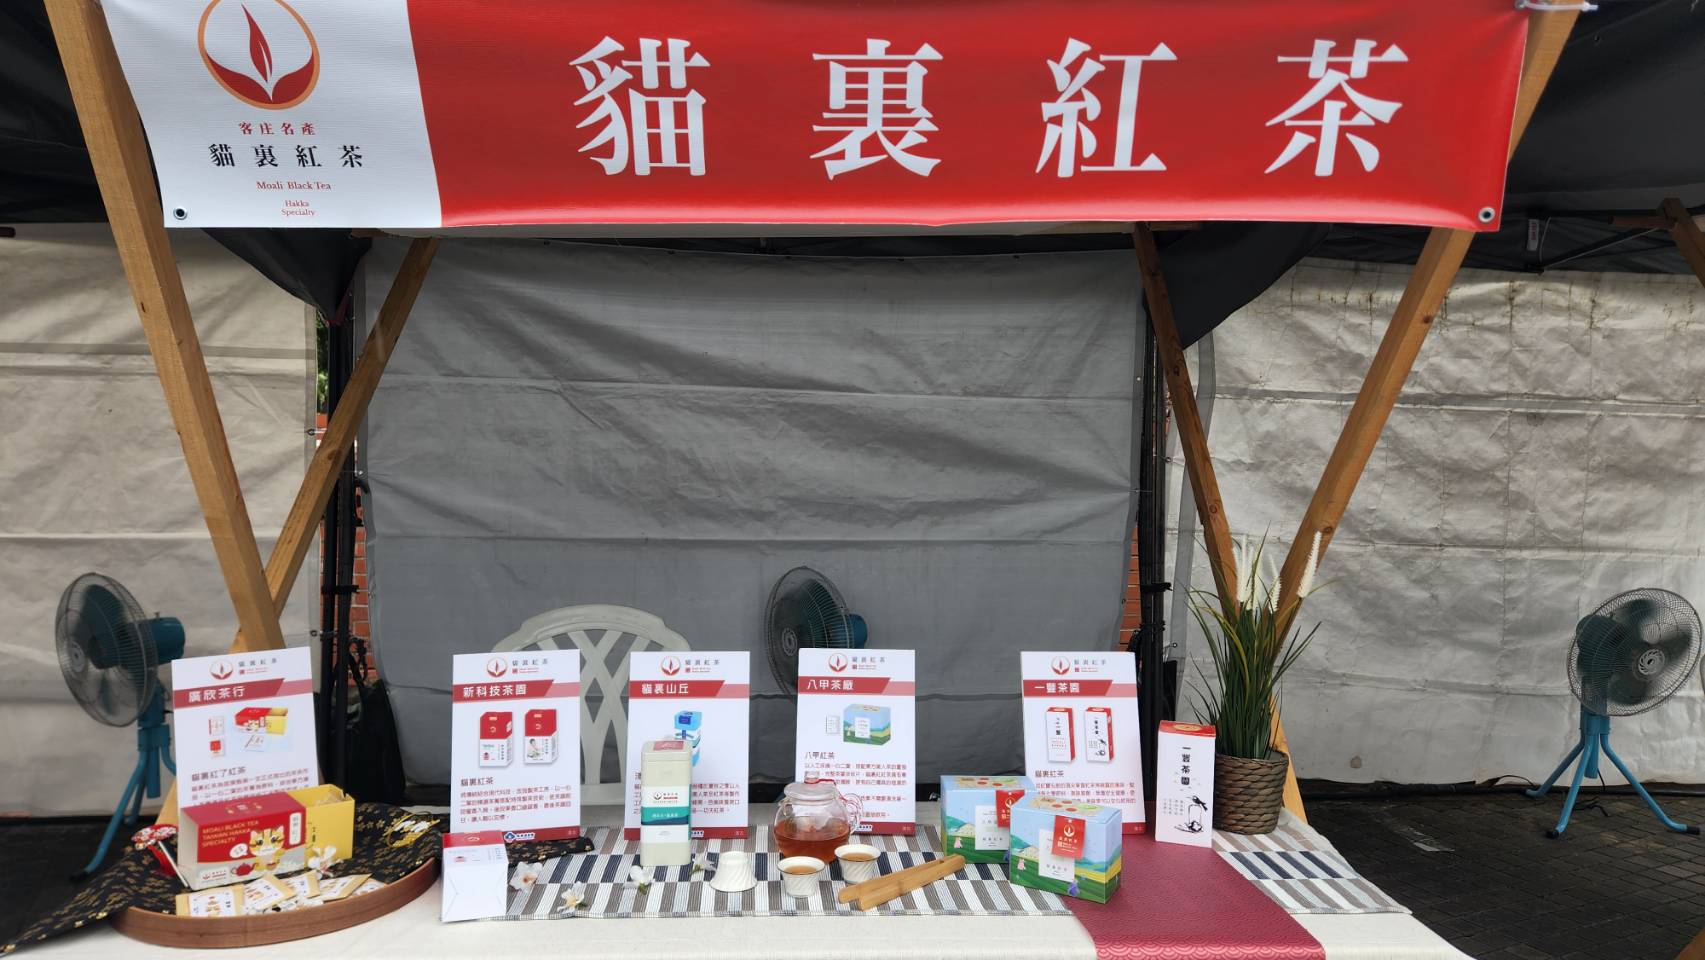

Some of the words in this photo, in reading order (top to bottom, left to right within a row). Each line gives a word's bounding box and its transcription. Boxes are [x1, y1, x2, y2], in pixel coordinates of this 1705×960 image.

[567, 35, 1410, 180] 貓裏紅茶
[239, 121, 316, 136] 客庄名產
[208, 143, 363, 168] 貓裏紅茶
[256, 181, 283, 190] Moali
[287, 181, 313, 190] Black
[313, 182, 332, 190] Tea
[284, 199, 310, 207] Hakka
[281, 208, 316, 217] Specialty
[463, 683, 527, 698] 新科技茶園
[641, 683, 689, 695] 貓裏山丘
[807, 679, 854, 691] 八甲茶廠
[1034, 682, 1080, 694] 一豐茶園
[188, 685, 246, 703] 廣欣茶行
[805, 751, 836, 760] 八甲紅茶
[225, 823, 246, 831] BLACK
[202, 837, 236, 847] SPECIALTY
